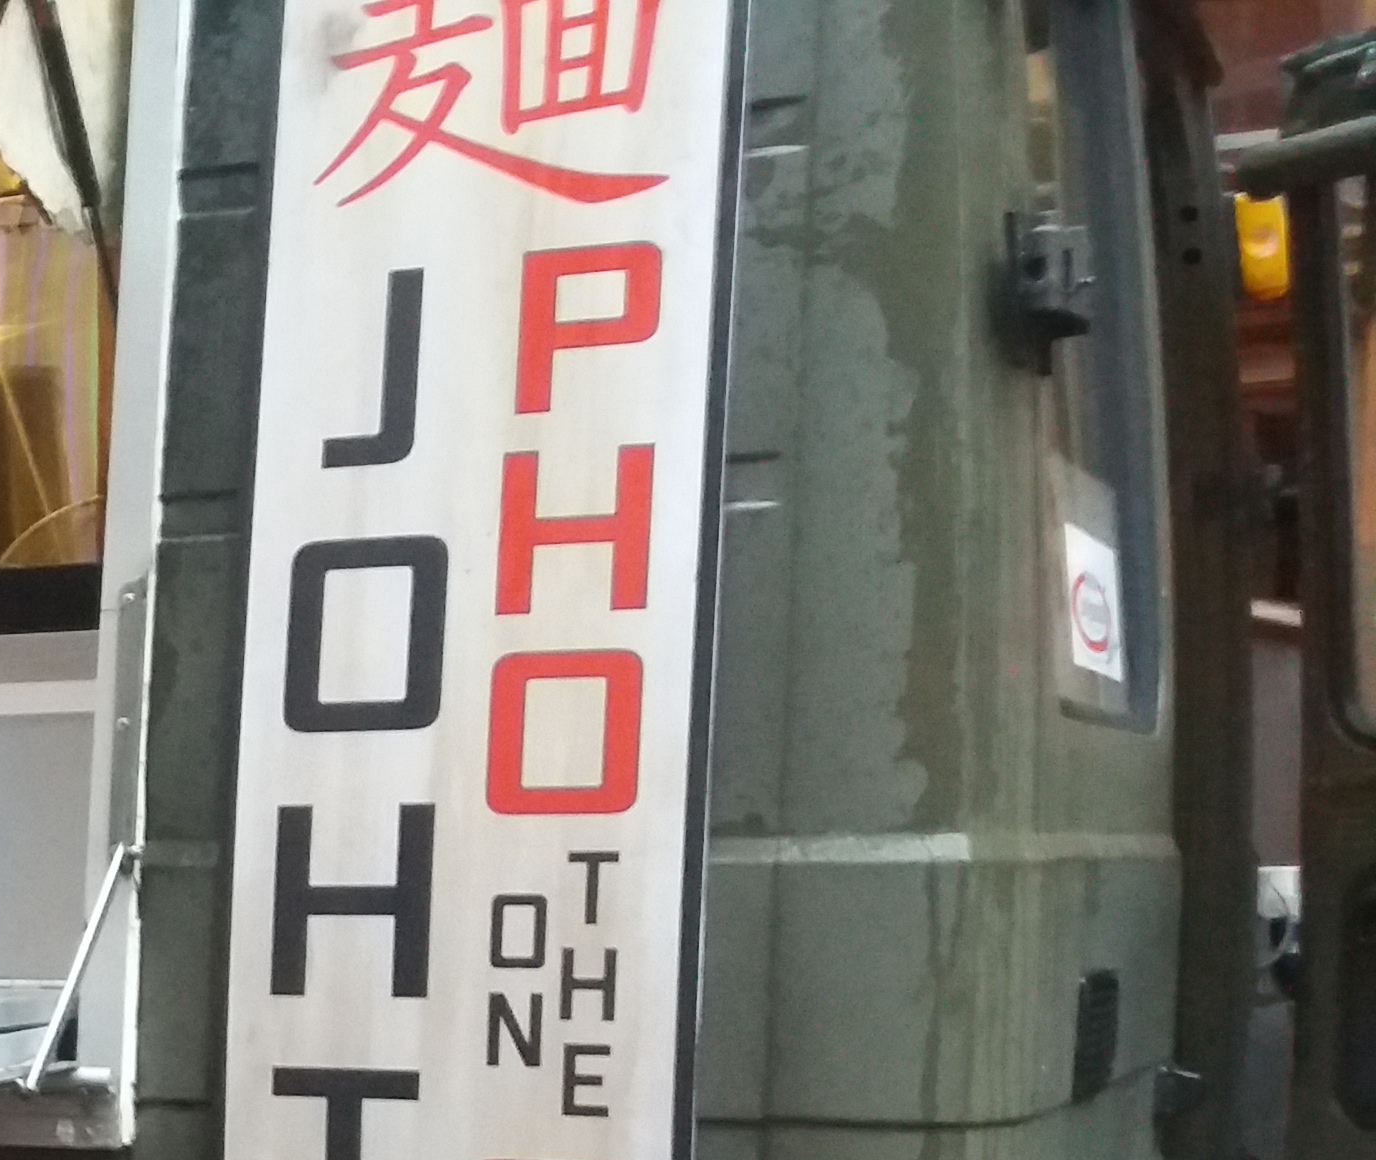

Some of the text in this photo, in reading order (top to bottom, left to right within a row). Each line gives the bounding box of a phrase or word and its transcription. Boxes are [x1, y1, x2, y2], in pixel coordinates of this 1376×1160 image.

[485, 240, 663, 815] PHO
[486, 894, 549, 1067] ON
[559, 850, 619, 1118] THE
